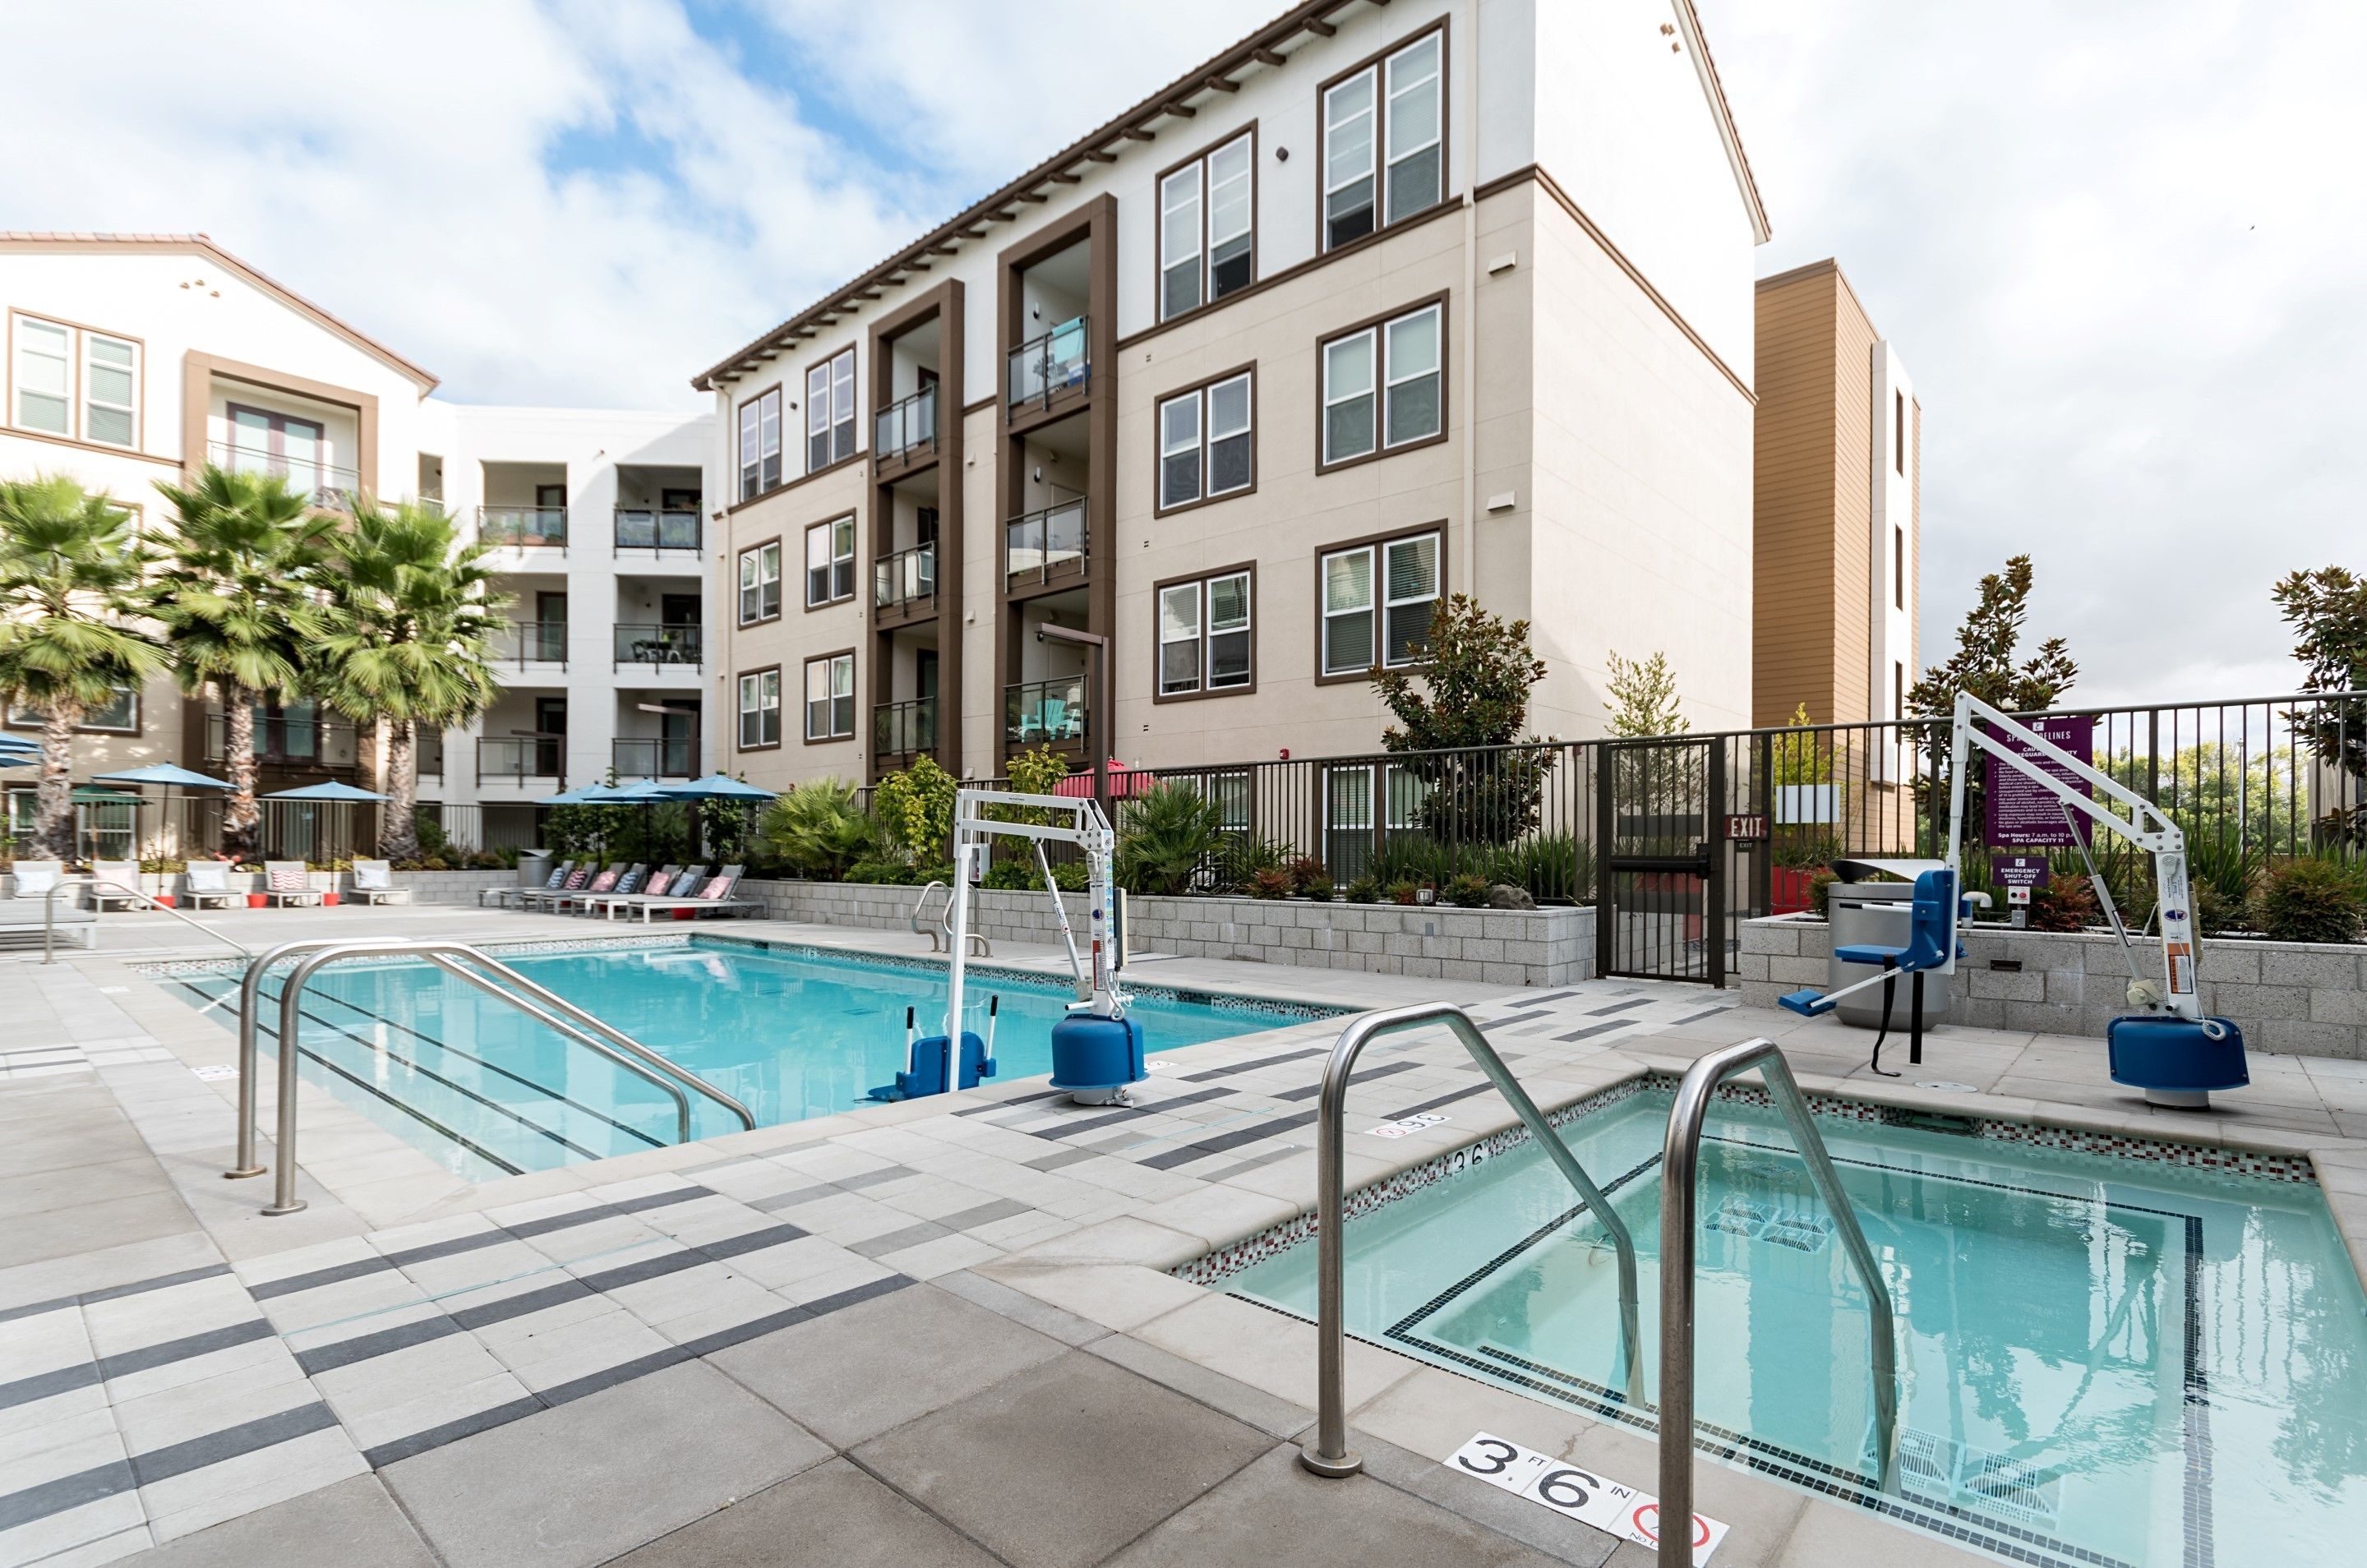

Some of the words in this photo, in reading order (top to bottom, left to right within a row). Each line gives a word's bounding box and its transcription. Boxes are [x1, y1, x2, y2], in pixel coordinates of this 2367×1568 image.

[1731, 818, 1762, 837] EXIT
[1453, 1151, 1465, 1174] 3
[1472, 1143, 1483, 1165] 6
[1459, 1439, 1519, 1474] 3
[1528, 1455, 1547, 1467] FT
[1539, 1469, 1600, 1508] 6
[1610, 1486, 1631, 1499] IN
